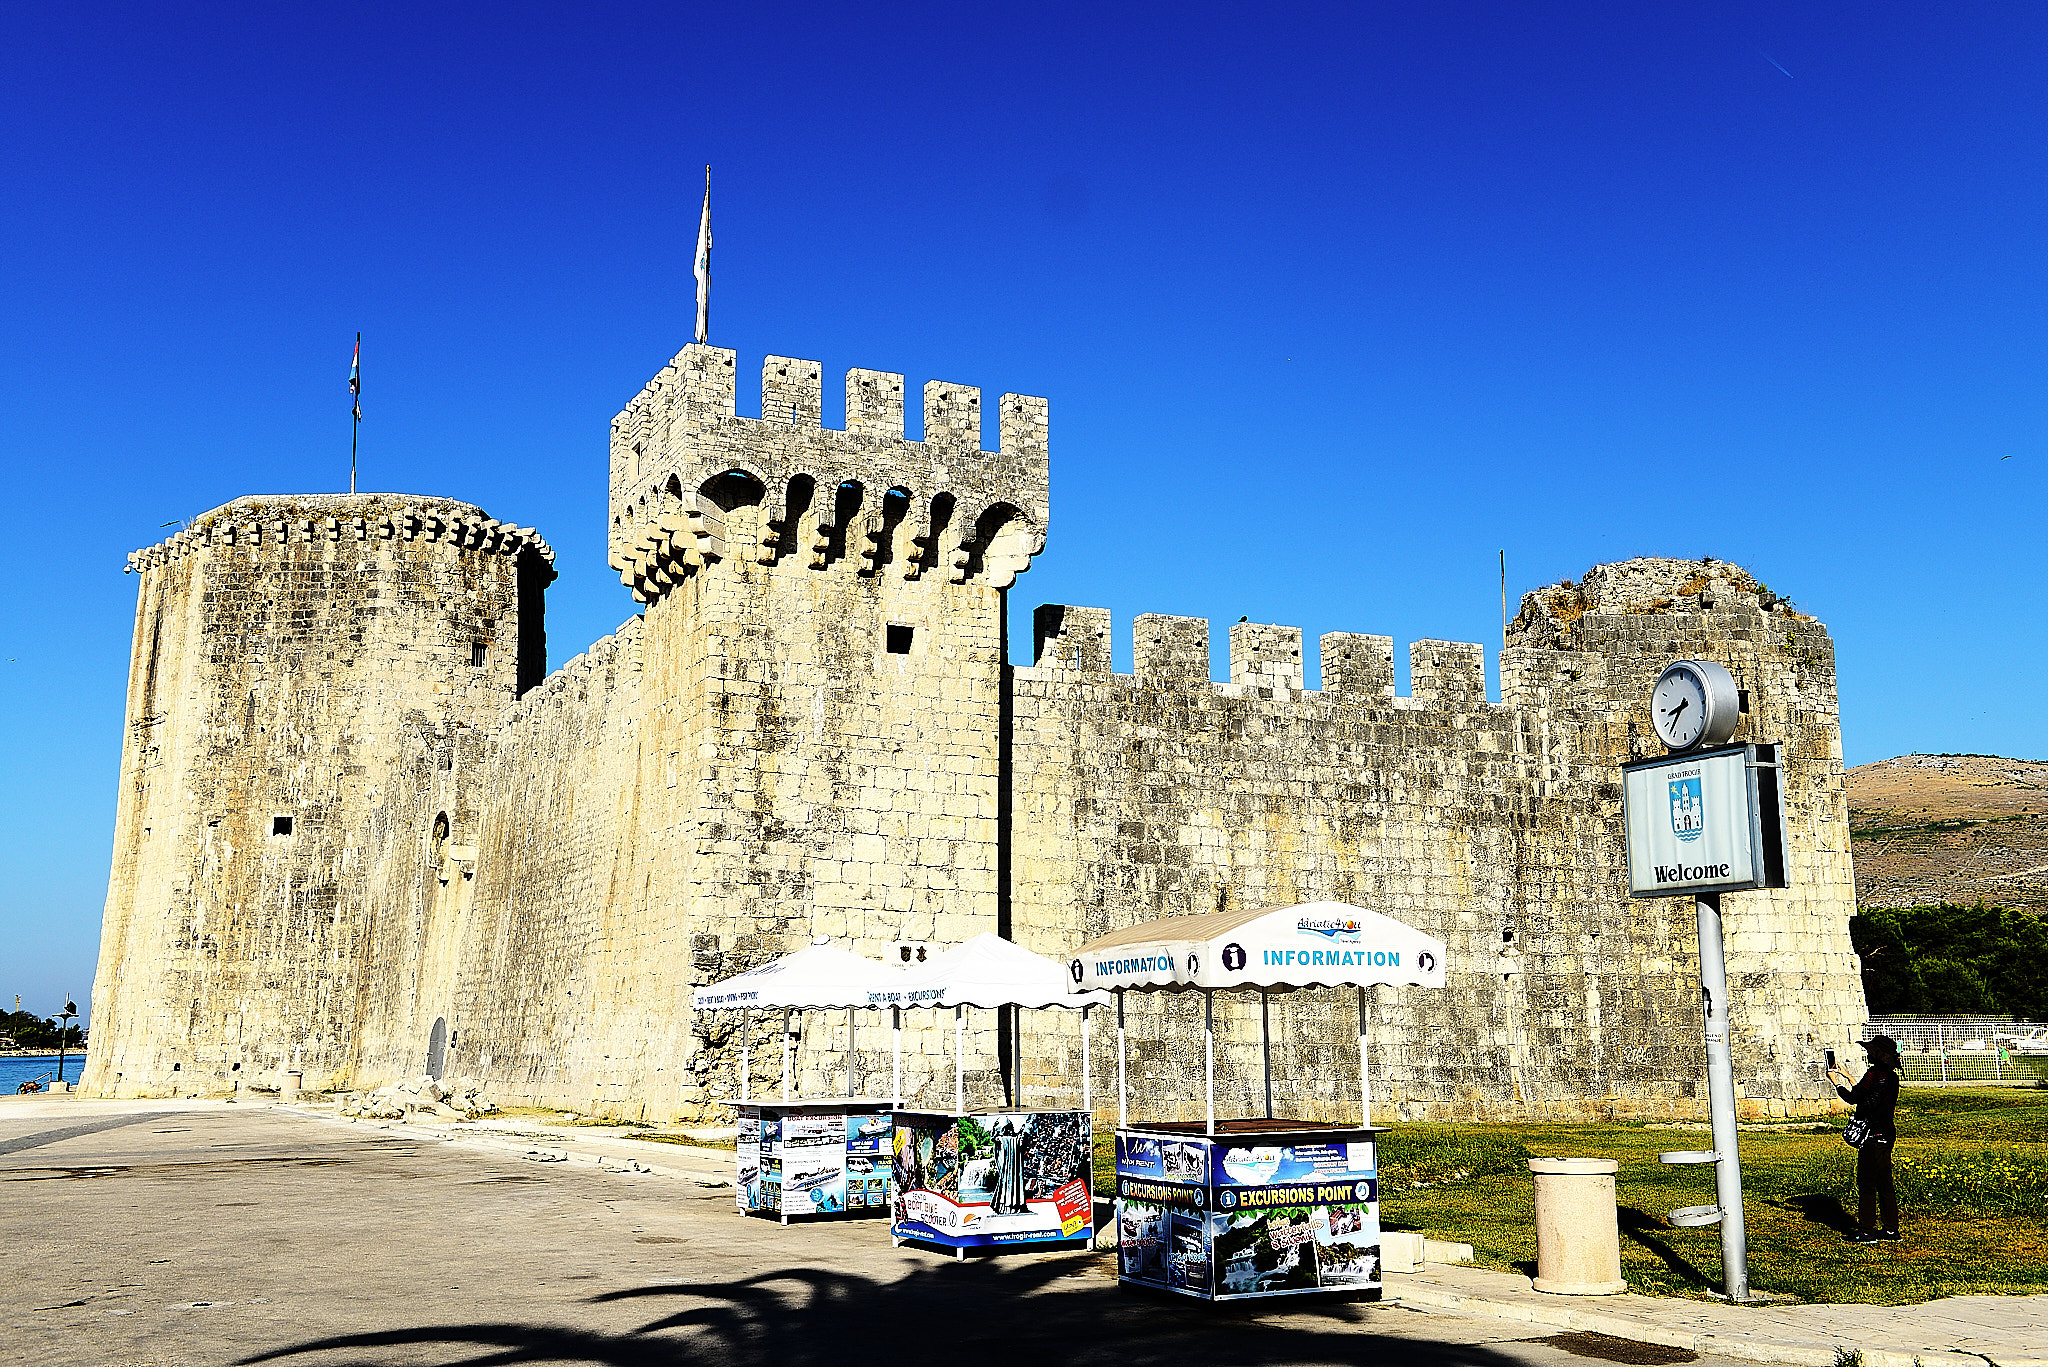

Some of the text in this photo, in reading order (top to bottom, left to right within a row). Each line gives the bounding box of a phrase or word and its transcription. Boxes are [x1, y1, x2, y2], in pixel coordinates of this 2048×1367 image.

[1668, 771, 1681, 779] GRAD
[1654, 864, 1730, 883] Welcome
[1096, 956, 1175, 976] INFORMATION
[1264, 950, 1399, 966] INFORMATION
[868, 992, 881, 1002] RENT
[888, 992, 901, 1002] BOAT
[908, 987, 946, 1001] EXCURSIONS
[1135, 1160, 1155, 1168] RENT
[1130, 1182, 1194, 1203] EXCURSIONS POINT
[1239, 1185, 1353, 1207] EXCURSIONS POINT
[924, 1203, 938, 1214] BIKE
